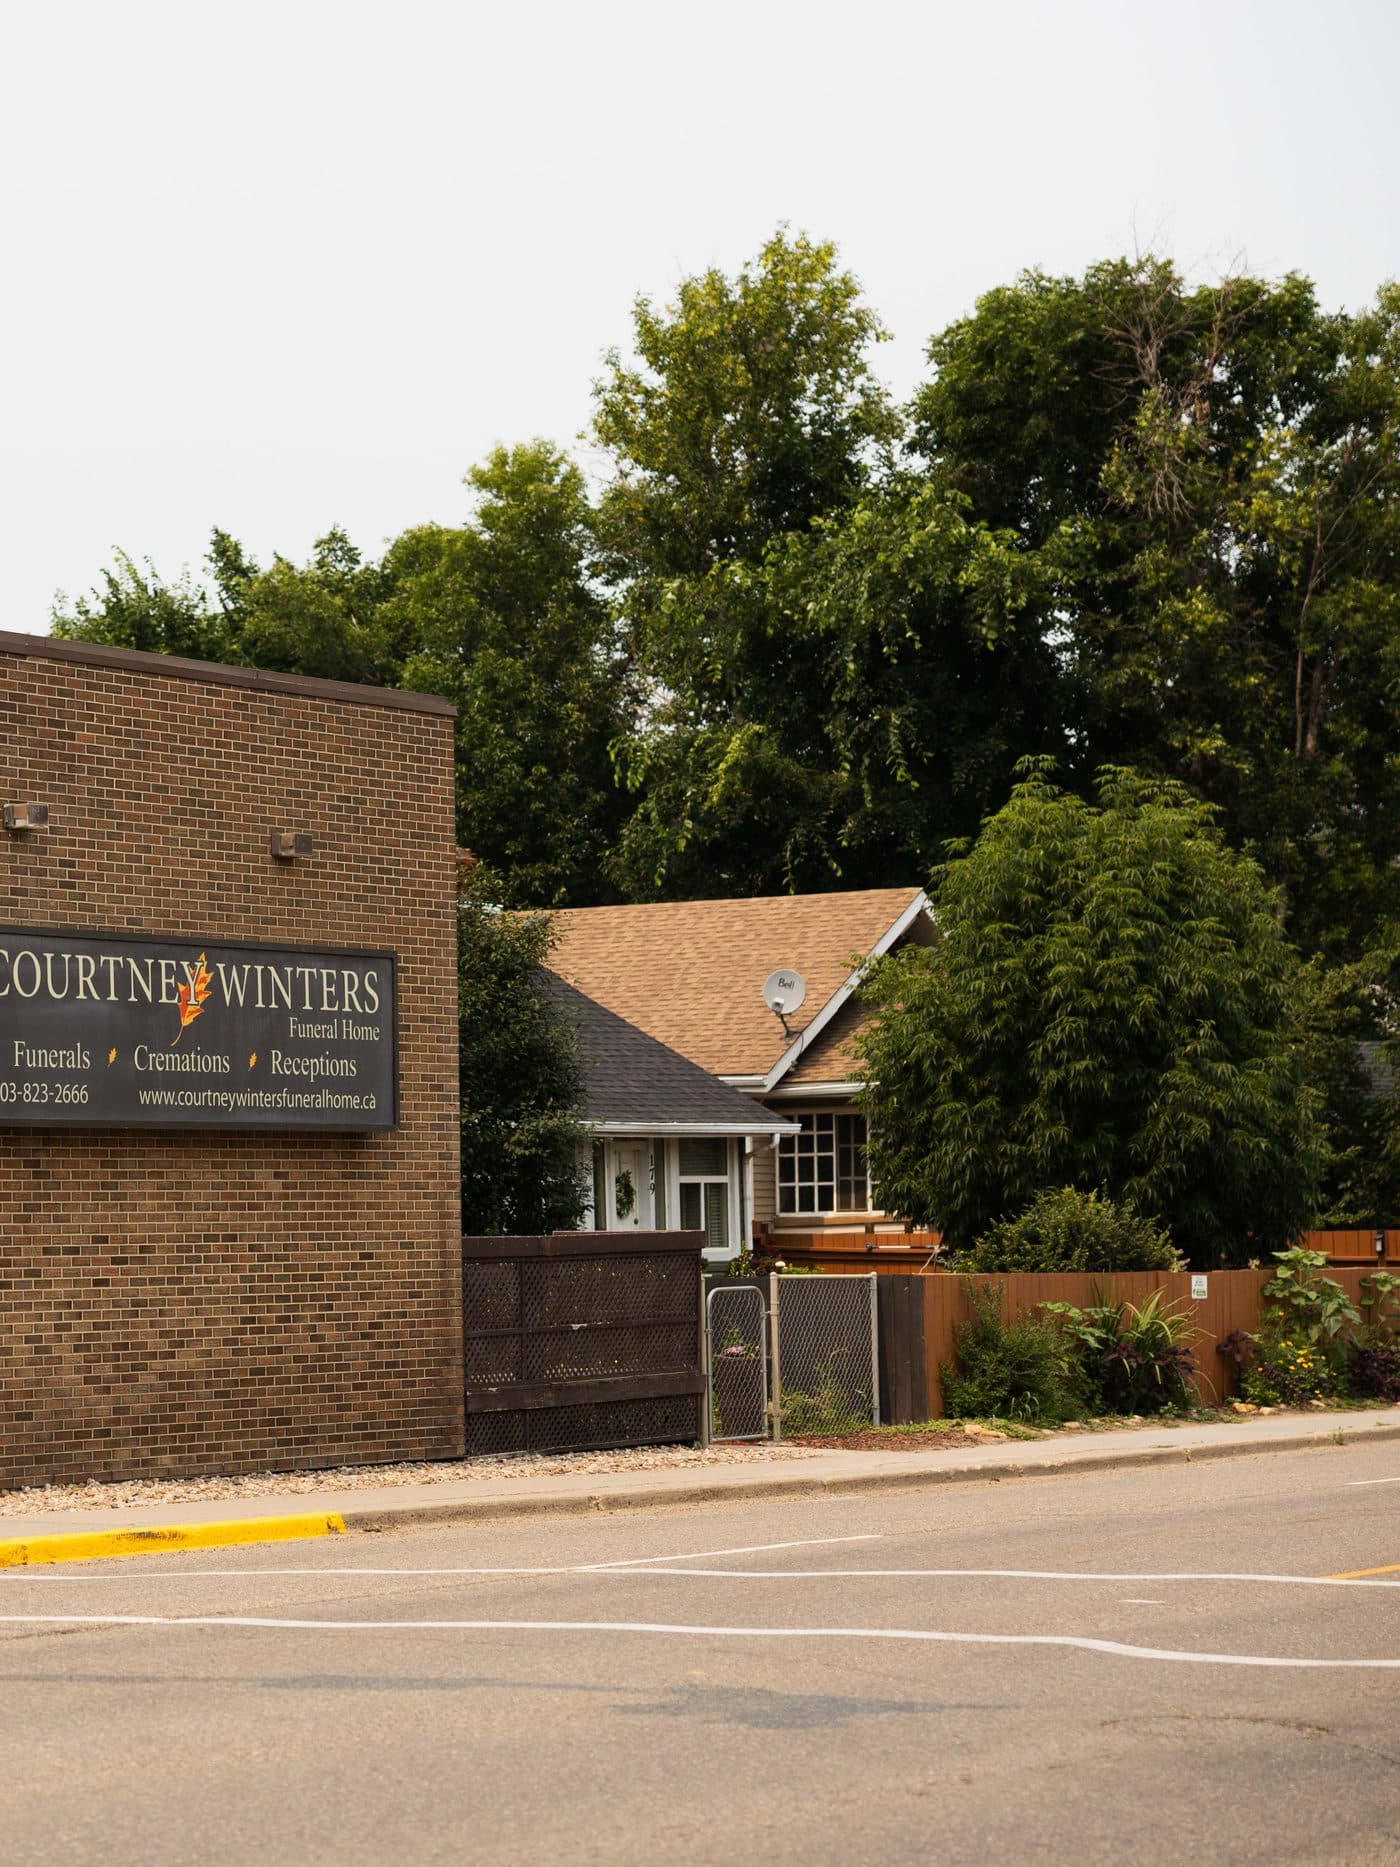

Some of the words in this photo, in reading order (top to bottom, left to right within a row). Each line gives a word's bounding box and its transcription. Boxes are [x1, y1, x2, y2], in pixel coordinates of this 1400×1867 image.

[216, 962, 379, 1014] WINTERS
[290, 1017, 338, 1039] Funeral
[342, 1019, 380, 1041] Home
[13, 1040, 91, 1069] Funerals
[134, 1045, 230, 1073] Cremations
[271, 1050, 357, 1082] Receptions
[139, 1087, 377, 1112] www.courtneywintersfuneralhome.ca
